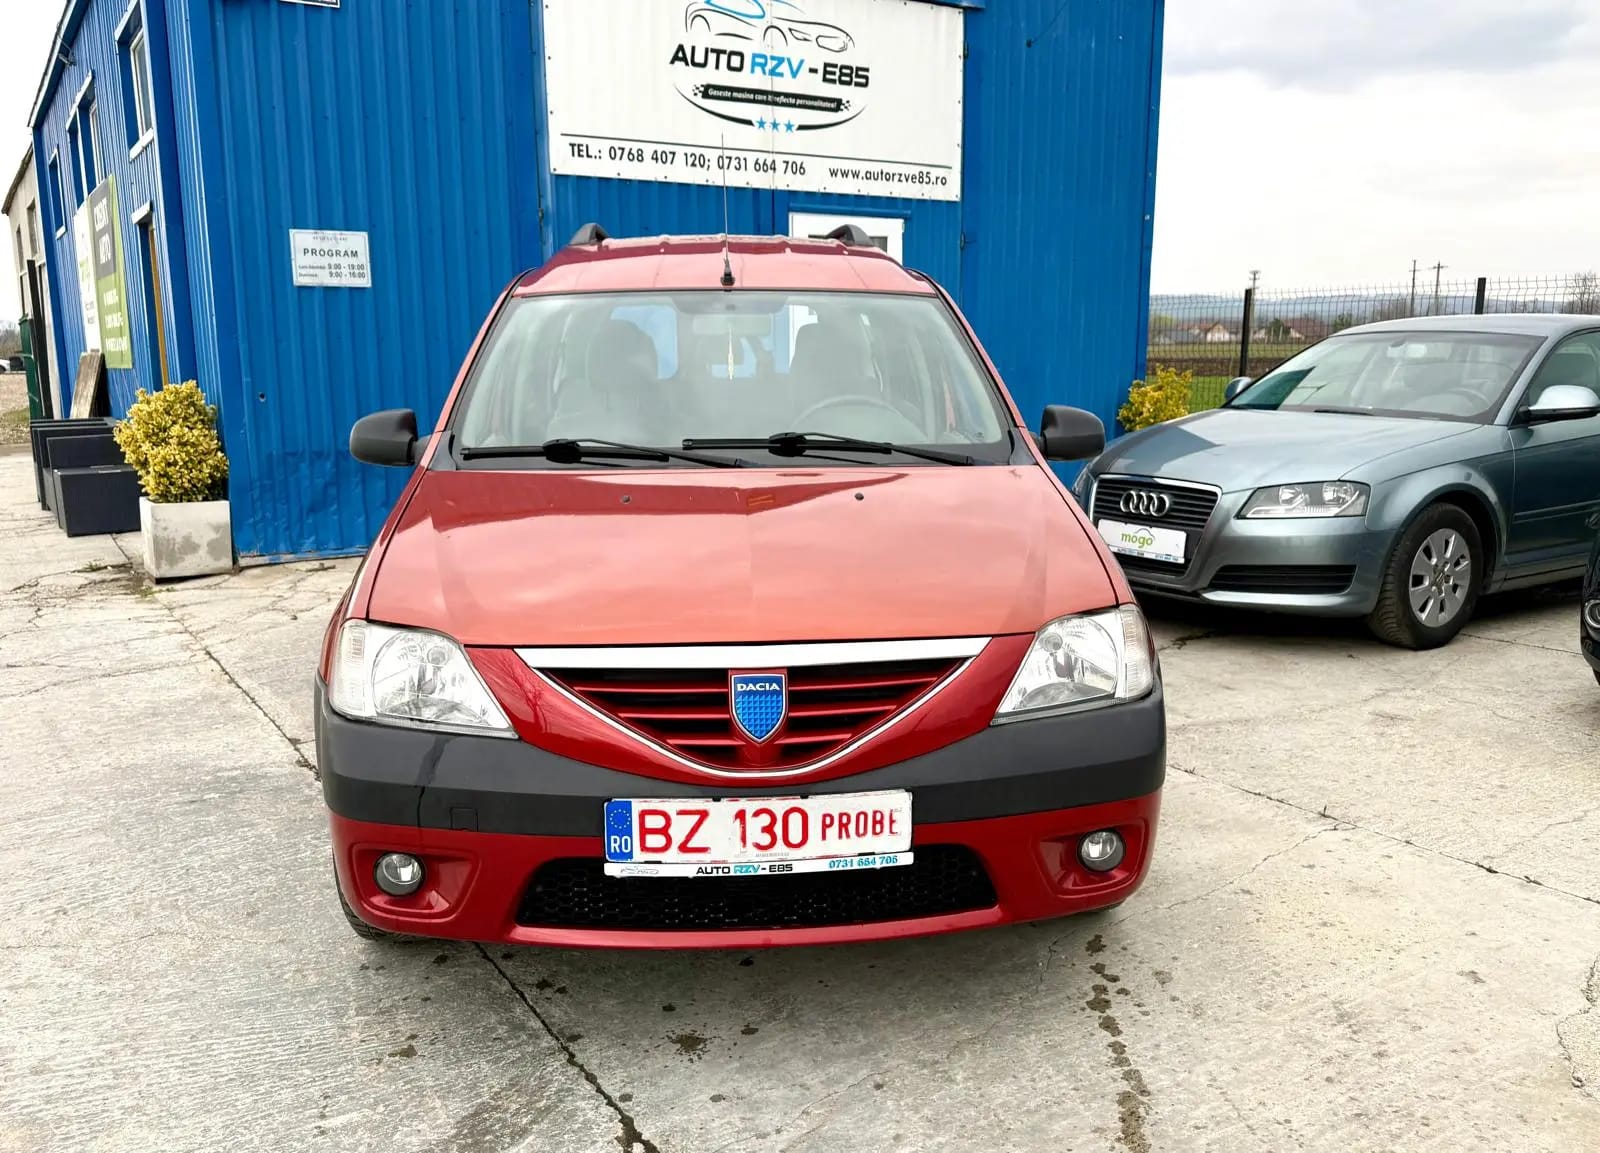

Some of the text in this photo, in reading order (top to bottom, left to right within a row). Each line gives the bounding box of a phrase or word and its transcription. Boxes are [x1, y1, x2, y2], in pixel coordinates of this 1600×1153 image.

[669, 43, 745, 73] AUTO
[750, 52, 805, 79] RZV
[822, 61, 870, 88] E85
[569, 142, 947, 186] TEL.: 0768 407 120; 0731 664 706 www.autorzve85.ro
[303, 248, 359, 258] PROGRAM
[1121, 532, 1153, 548] mogo
[736, 682, 780, 691] DACIA
[638, 806, 901, 853] BZ 130 PROBE
[611, 835, 631, 853] RO
[696, 866, 731, 875] AUTO
